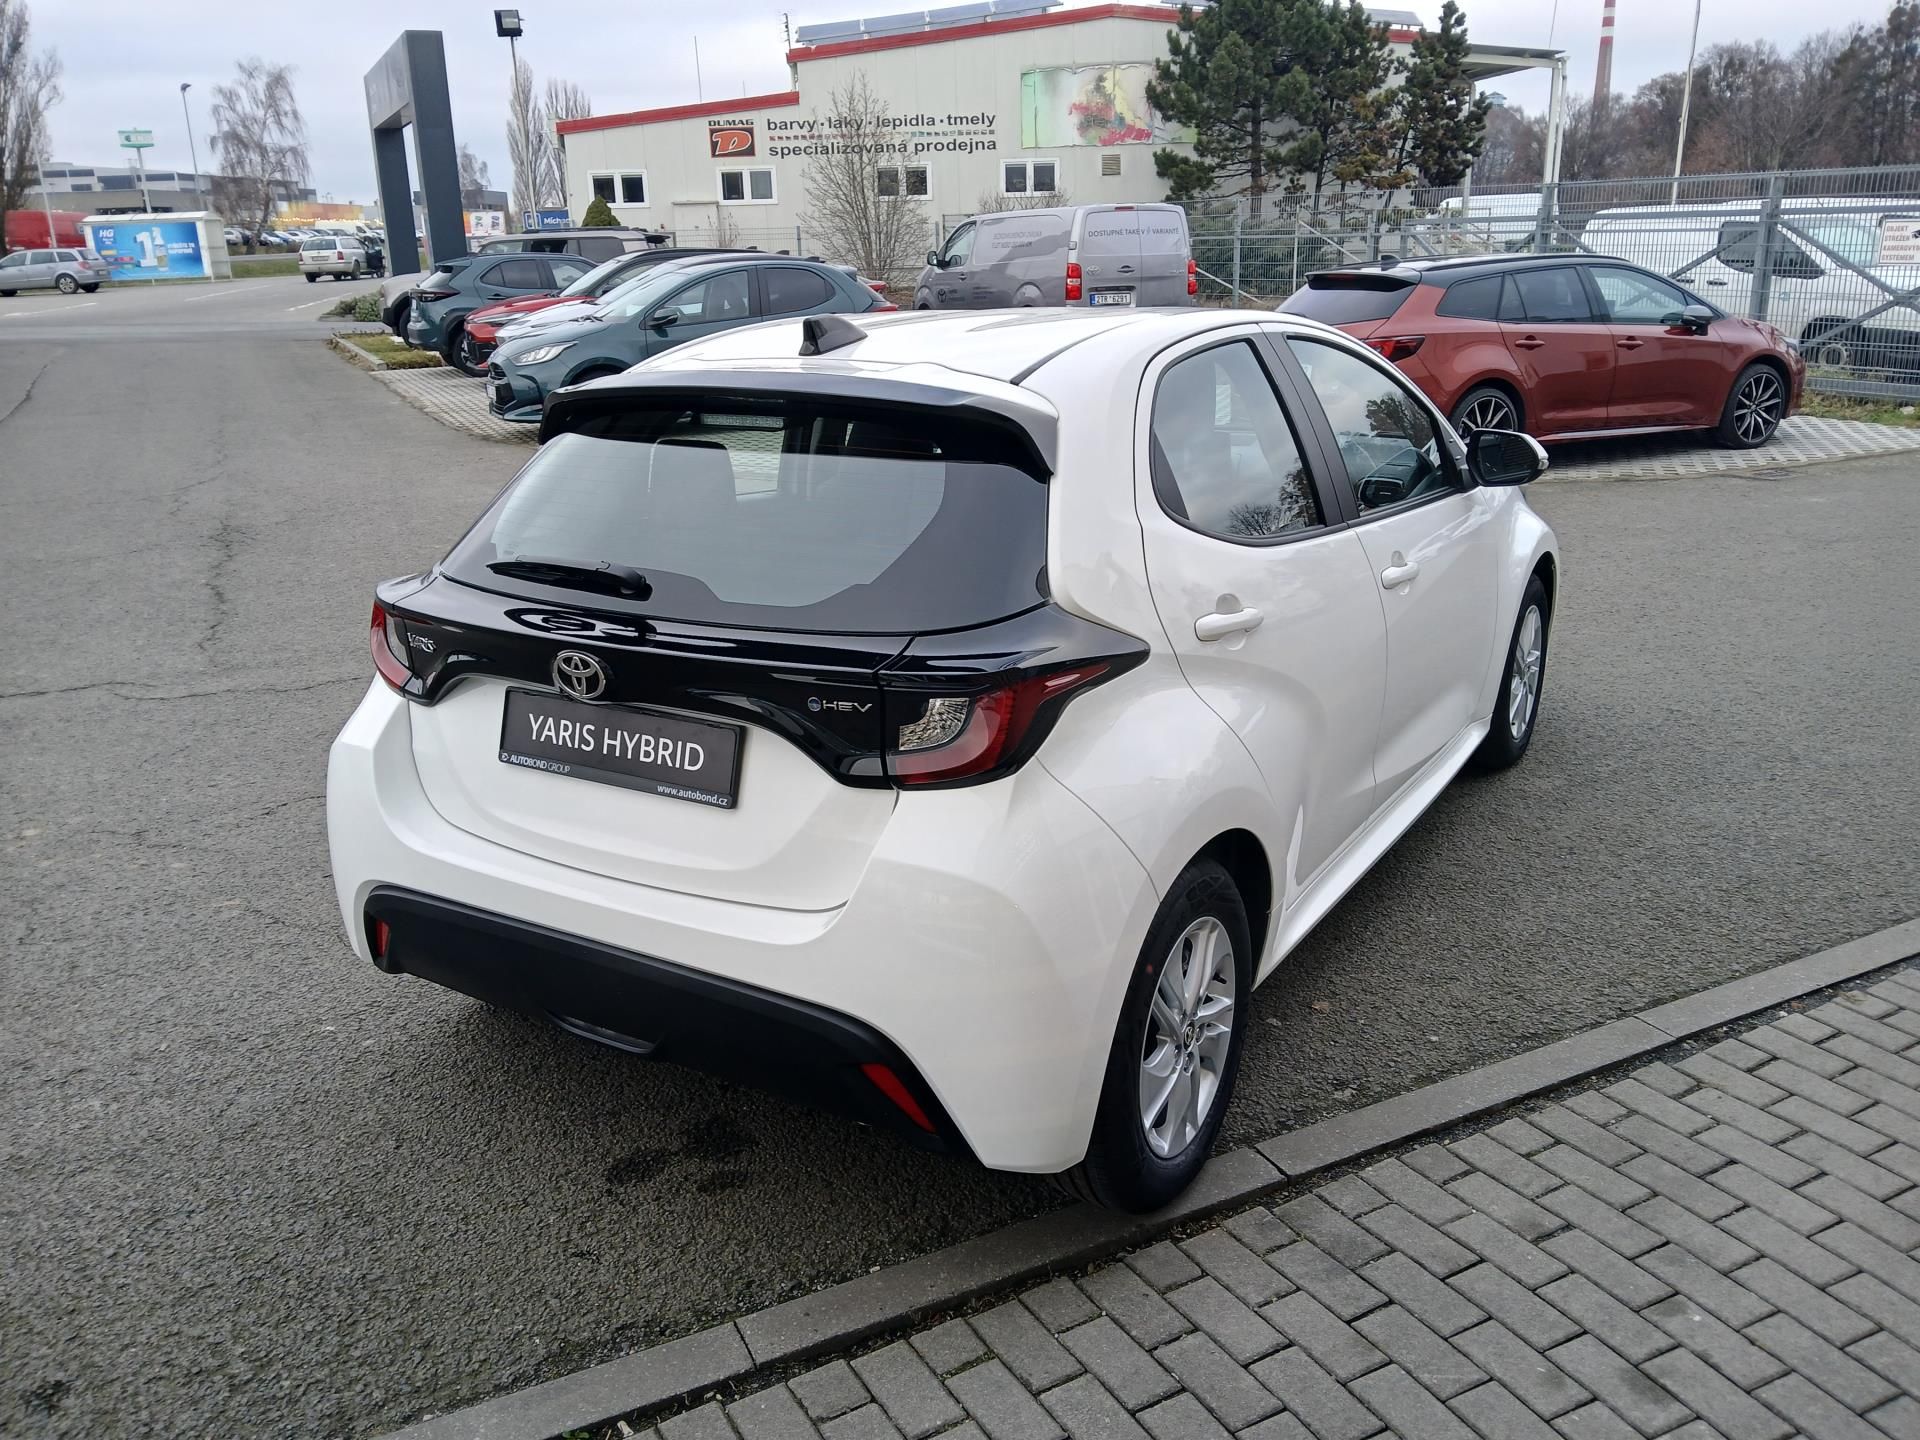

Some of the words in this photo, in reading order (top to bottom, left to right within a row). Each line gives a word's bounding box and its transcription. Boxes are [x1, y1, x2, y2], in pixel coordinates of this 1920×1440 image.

[708, 119, 754, 127] DUMAG
[767, 118, 817, 132] barvy
[828, 117, 864, 130] laky
[876, 114, 936, 129] lepidla
[947, 112, 996, 127] tmely
[768, 140, 908, 159] specializovaná
[914, 138, 997, 155] prodejna
[99, 229, 114, 238] HG
[822, 699, 873, 713] HEV
[528, 713, 596, 751] YARIS
[602, 727, 705, 771] HYBRID
[510, 754, 547, 769] AUTOBOND
[548, 762, 571, 773] GROUP
[657, 784, 728, 806] www.autobond.cz
